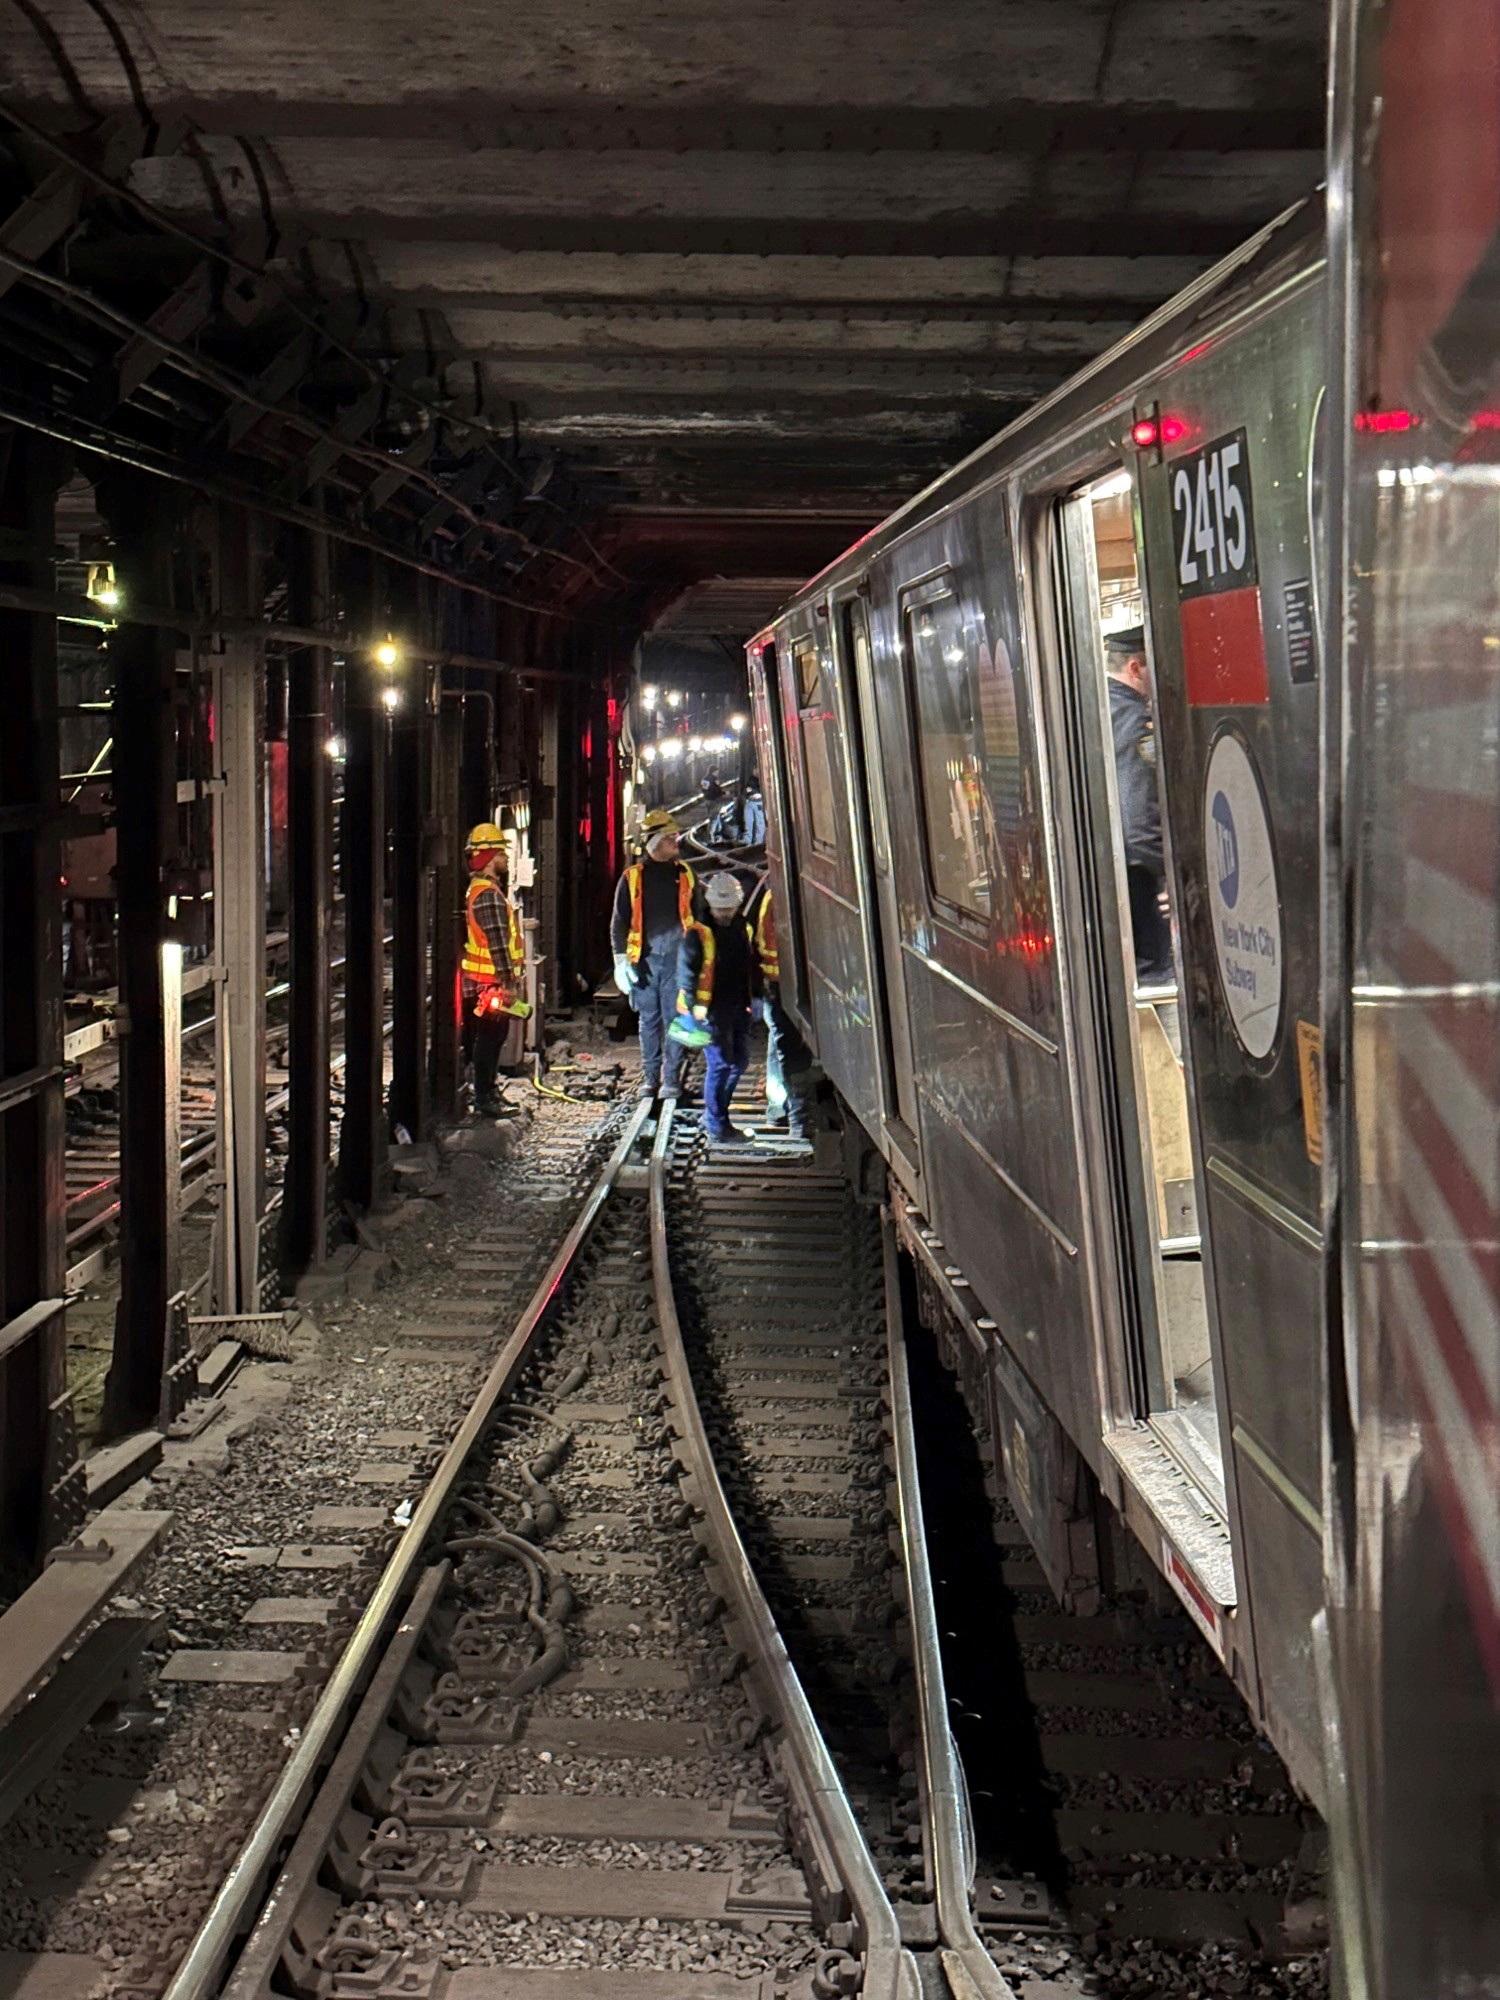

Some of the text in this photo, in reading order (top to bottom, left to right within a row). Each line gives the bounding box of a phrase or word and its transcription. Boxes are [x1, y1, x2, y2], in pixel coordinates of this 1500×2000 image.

[1174, 442, 1246, 584] 2415
[1222, 919, 1276, 967] New York City
[1225, 957, 1257, 1000] Subway
